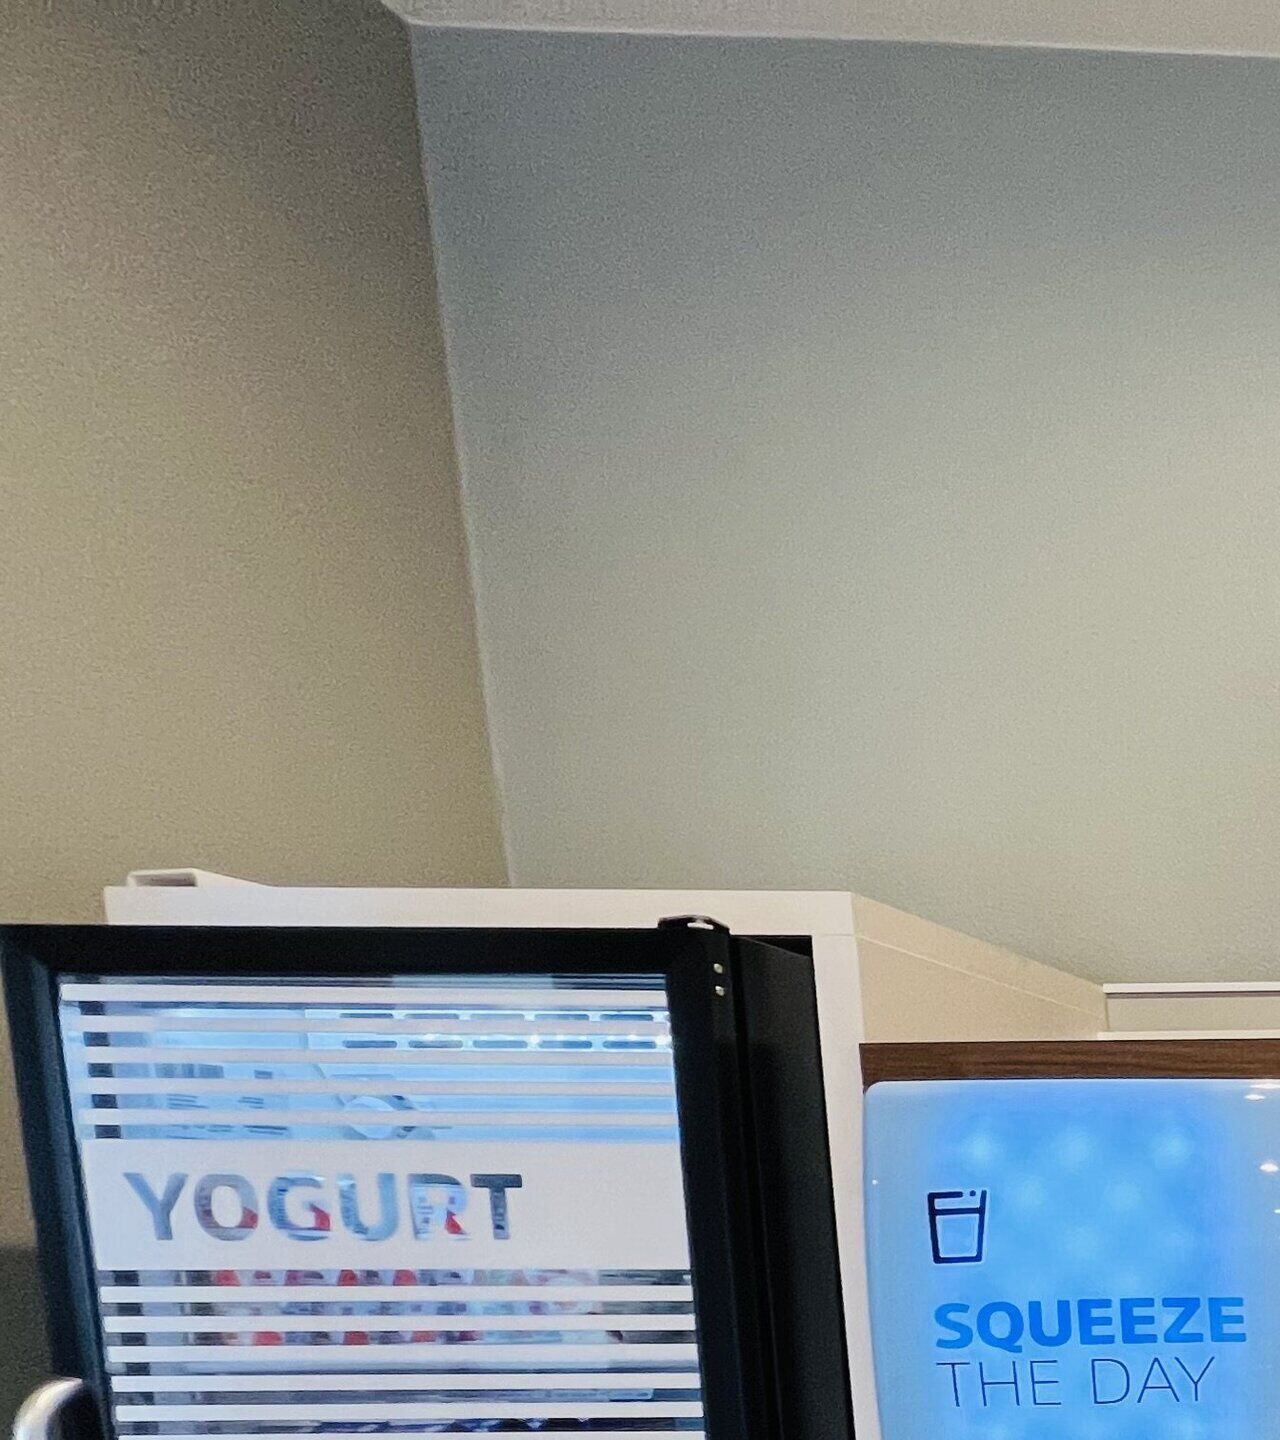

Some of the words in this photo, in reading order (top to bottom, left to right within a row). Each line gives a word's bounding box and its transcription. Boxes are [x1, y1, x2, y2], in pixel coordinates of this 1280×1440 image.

[122, 1172, 524, 1242] YOGURT
[933, 1297, 1248, 1354] SQUEEZE
[936, 1360, 1063, 1408] THE
[1091, 1355, 1216, 1406] DAY
